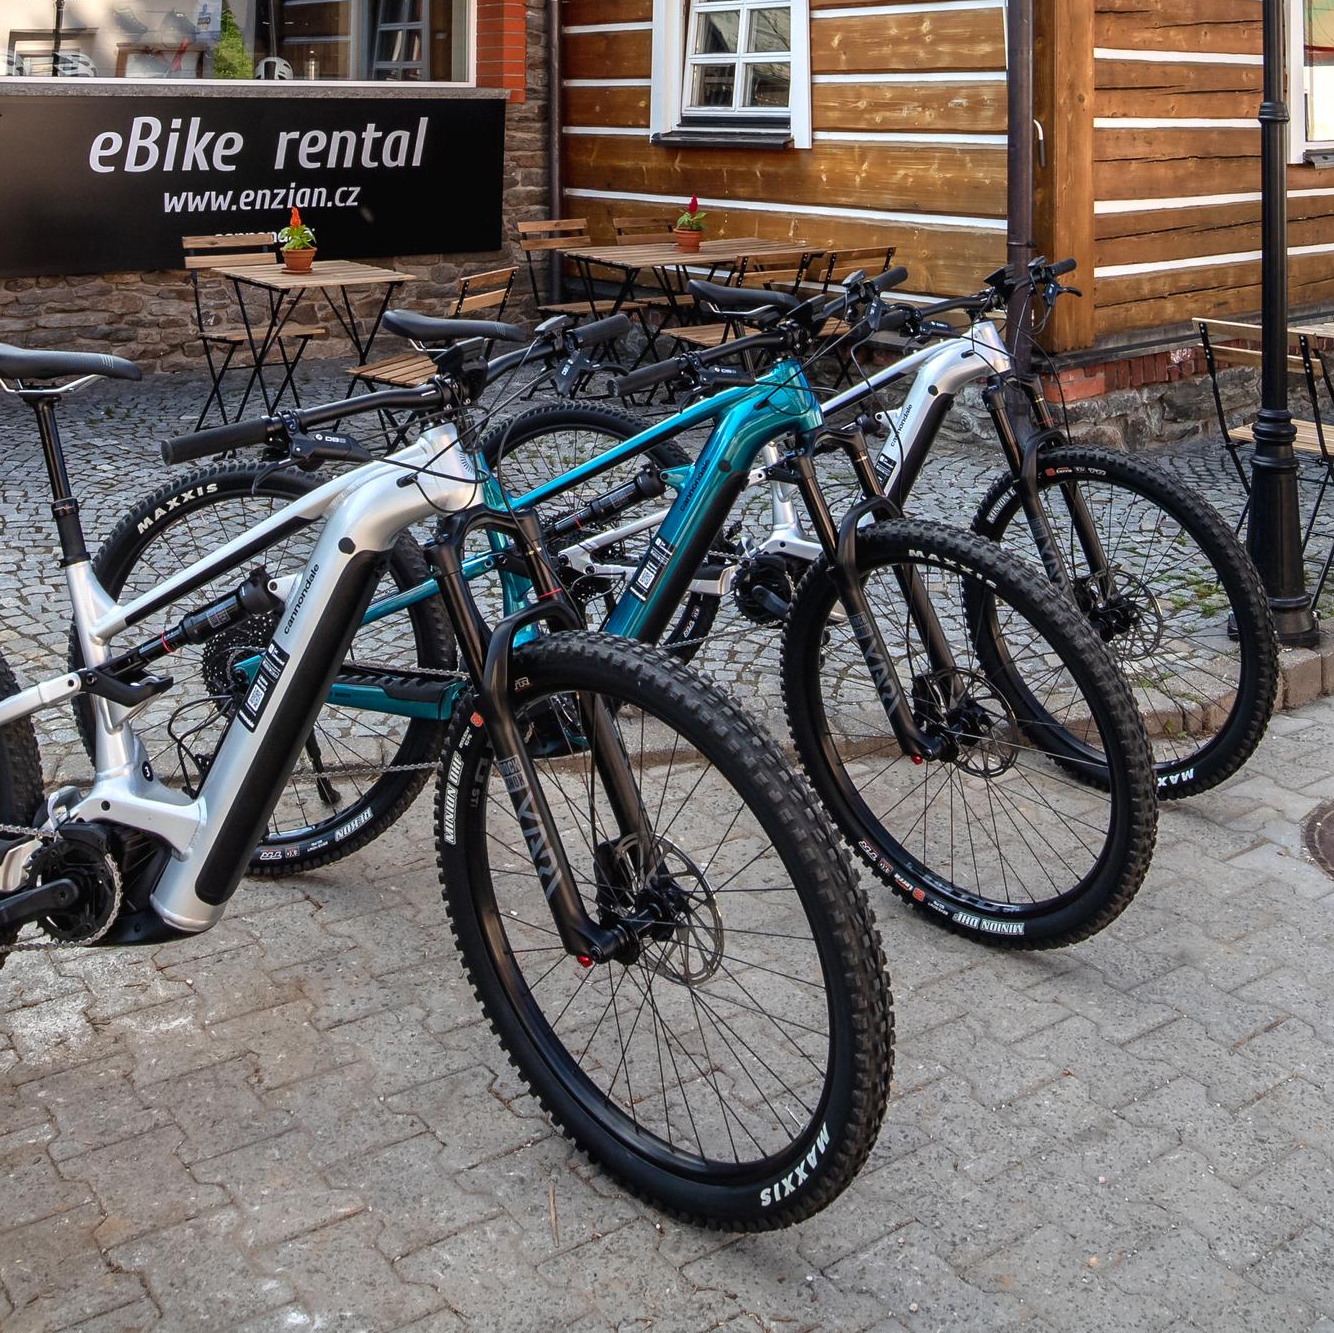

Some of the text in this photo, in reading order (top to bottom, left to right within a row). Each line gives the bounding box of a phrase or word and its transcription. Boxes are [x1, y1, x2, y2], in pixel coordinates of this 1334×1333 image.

[89, 116, 429, 173] eBike rental
[163, 185, 362, 214] www.enzian.cz
[137, 483, 218, 535] MAXXIS
[908, 549, 997, 589] MAXXIS
[284, 563, 320, 635] cannondale
[1157, 768, 1194, 787] MAX
[444, 783, 459, 846] MINION
[980, 917, 1025, 936] MINION
[760, 1121, 830, 1207] MAXXIS
